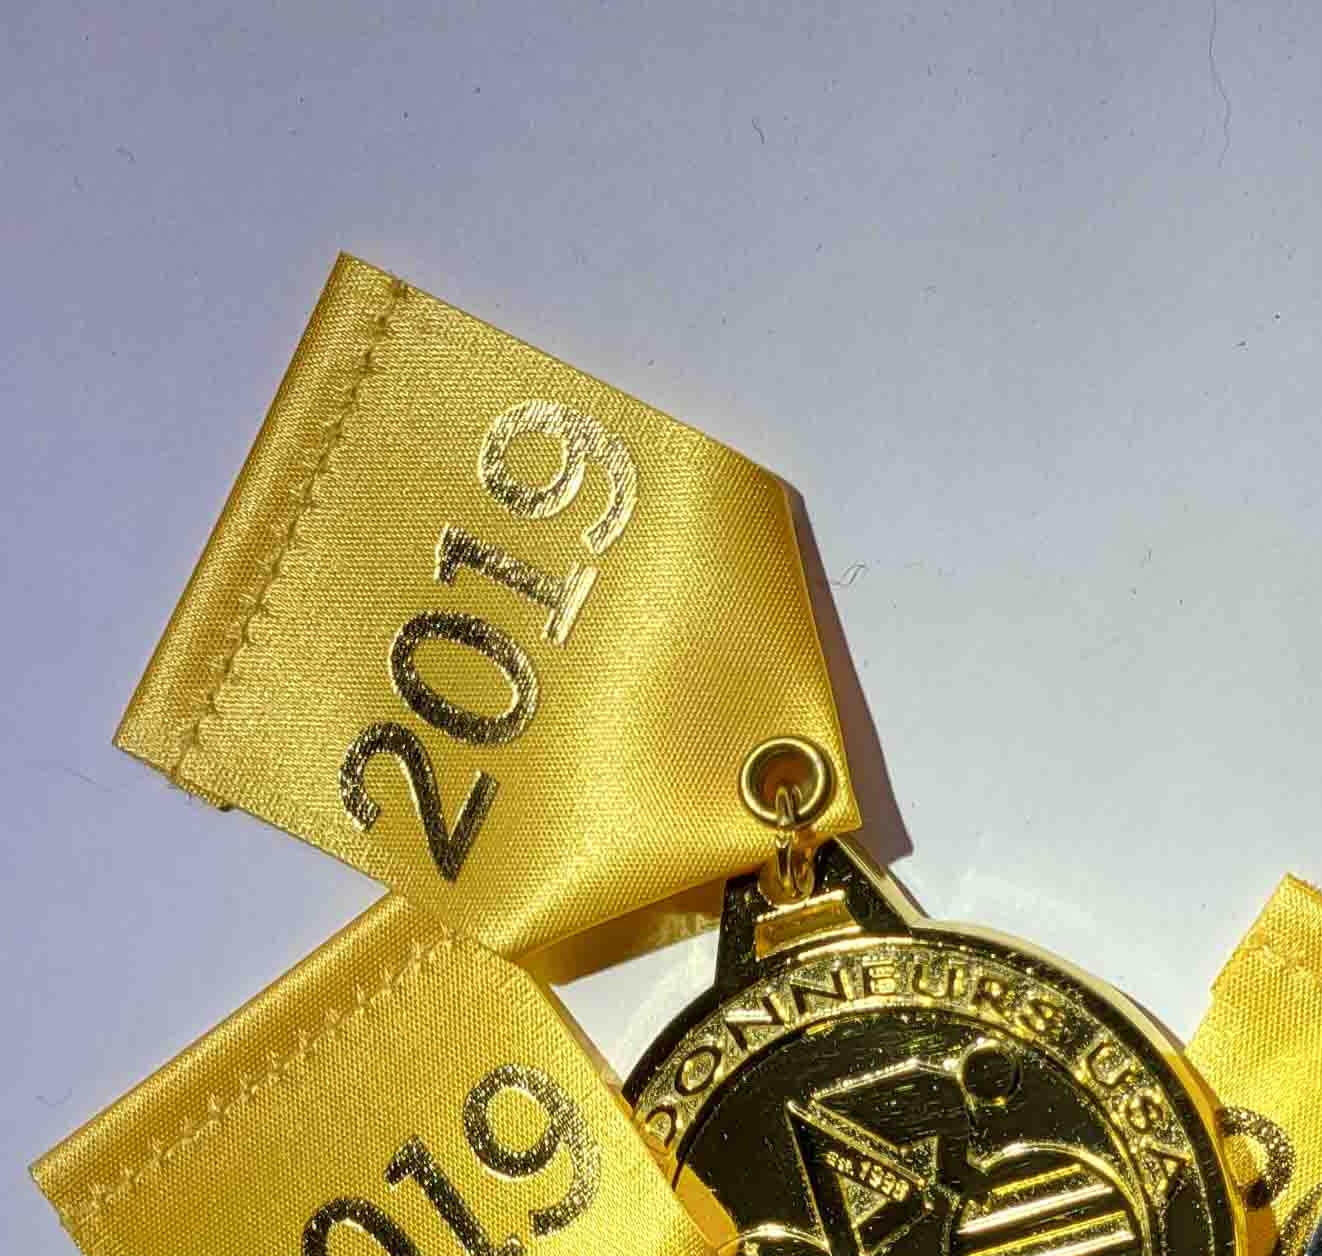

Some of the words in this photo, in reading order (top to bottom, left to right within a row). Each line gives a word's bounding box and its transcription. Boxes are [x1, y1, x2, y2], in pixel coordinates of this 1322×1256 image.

[339, 400, 638, 884] 2019
[644, 958, 1066, 1149] DONNEURS
[1078, 1040, 1196, 1196] USA
